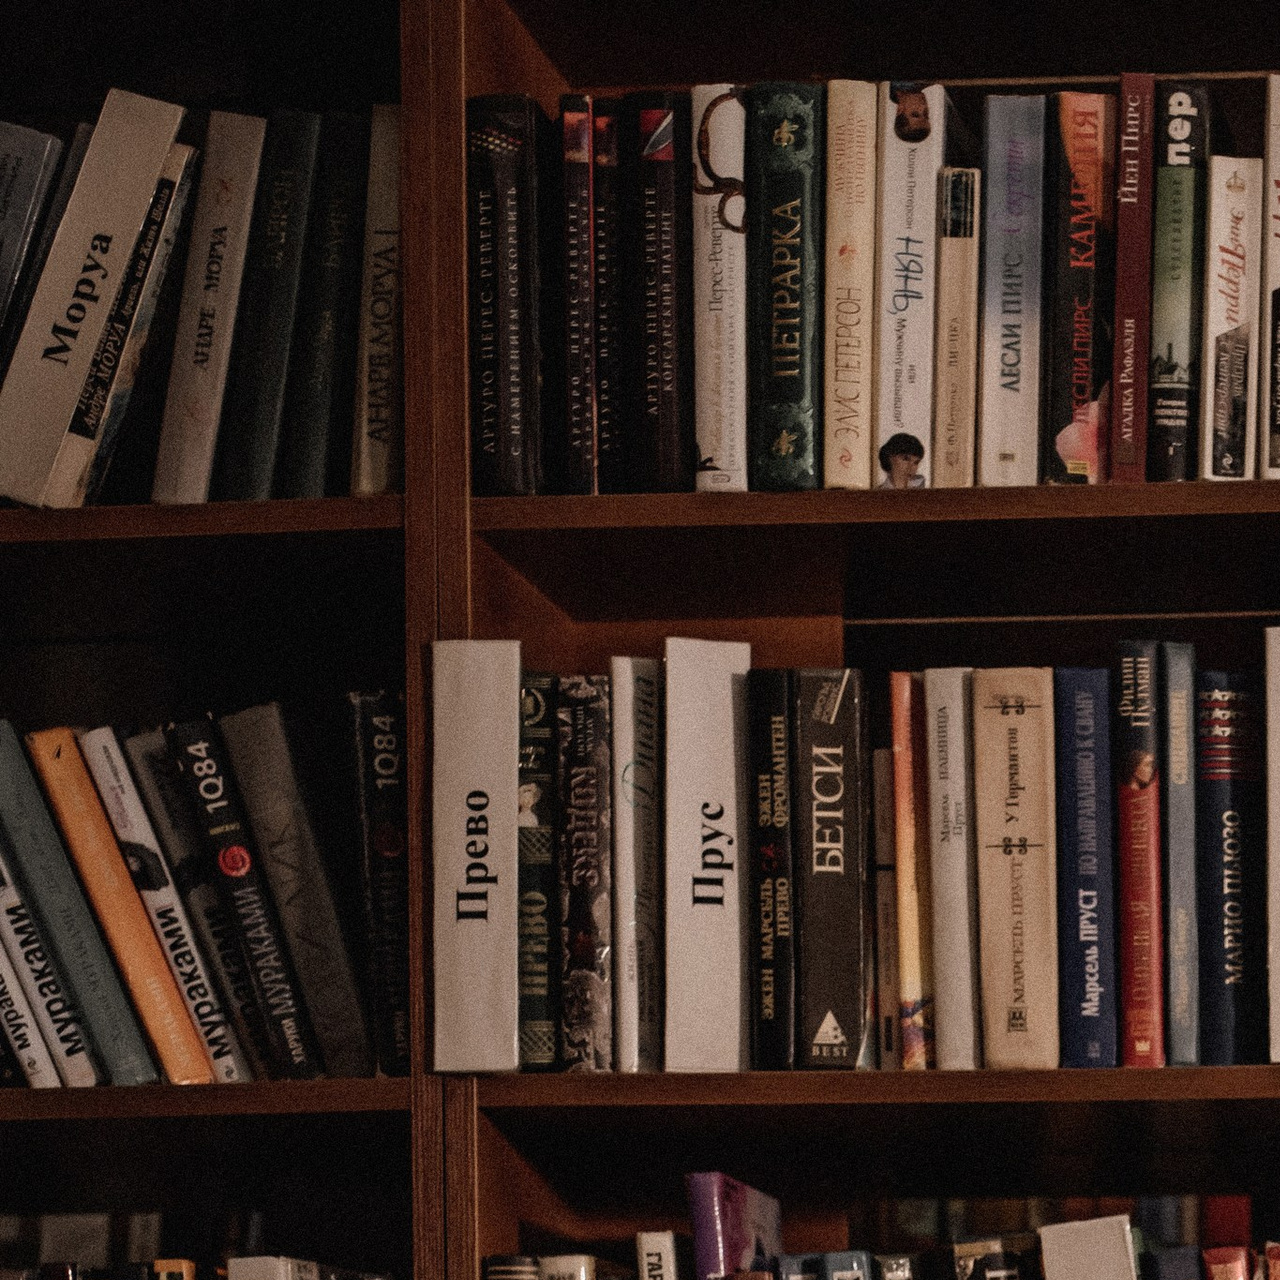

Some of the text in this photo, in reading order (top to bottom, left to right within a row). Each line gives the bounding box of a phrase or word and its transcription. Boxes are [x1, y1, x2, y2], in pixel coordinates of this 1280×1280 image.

[40, 233, 113, 366] Моруа
[204, 226, 229, 293] МОРУА
[369, 246, 395, 348] МОРУА
[773, 198, 801, 377] ПЕТРАРКА
[835, 287, 861, 383] ПЕТЕРСОН
[1000, 252, 1024, 392] ЛЕСЛИ ПИРС
[478, 369, 496, 454] АРТУРО
[645, 344, 659, 415] АРТУРО
[187, 739, 230, 815] 1Q84
[372, 714, 399, 790] 1Q84
[455, 789, 498, 922] Прево
[691, 800, 734, 907] Прус
[811, 744, 845, 875] БЕТСИ
[234, 885, 297, 1016] МУРАКАМИ
[775, 877, 790, 937] ПРЕВО
[1078, 888, 1102, 1017] Марсель ПРУСТ
[1224, 902, 1245, 984] МАРИО
[154, 906, 235, 1061] мураками
